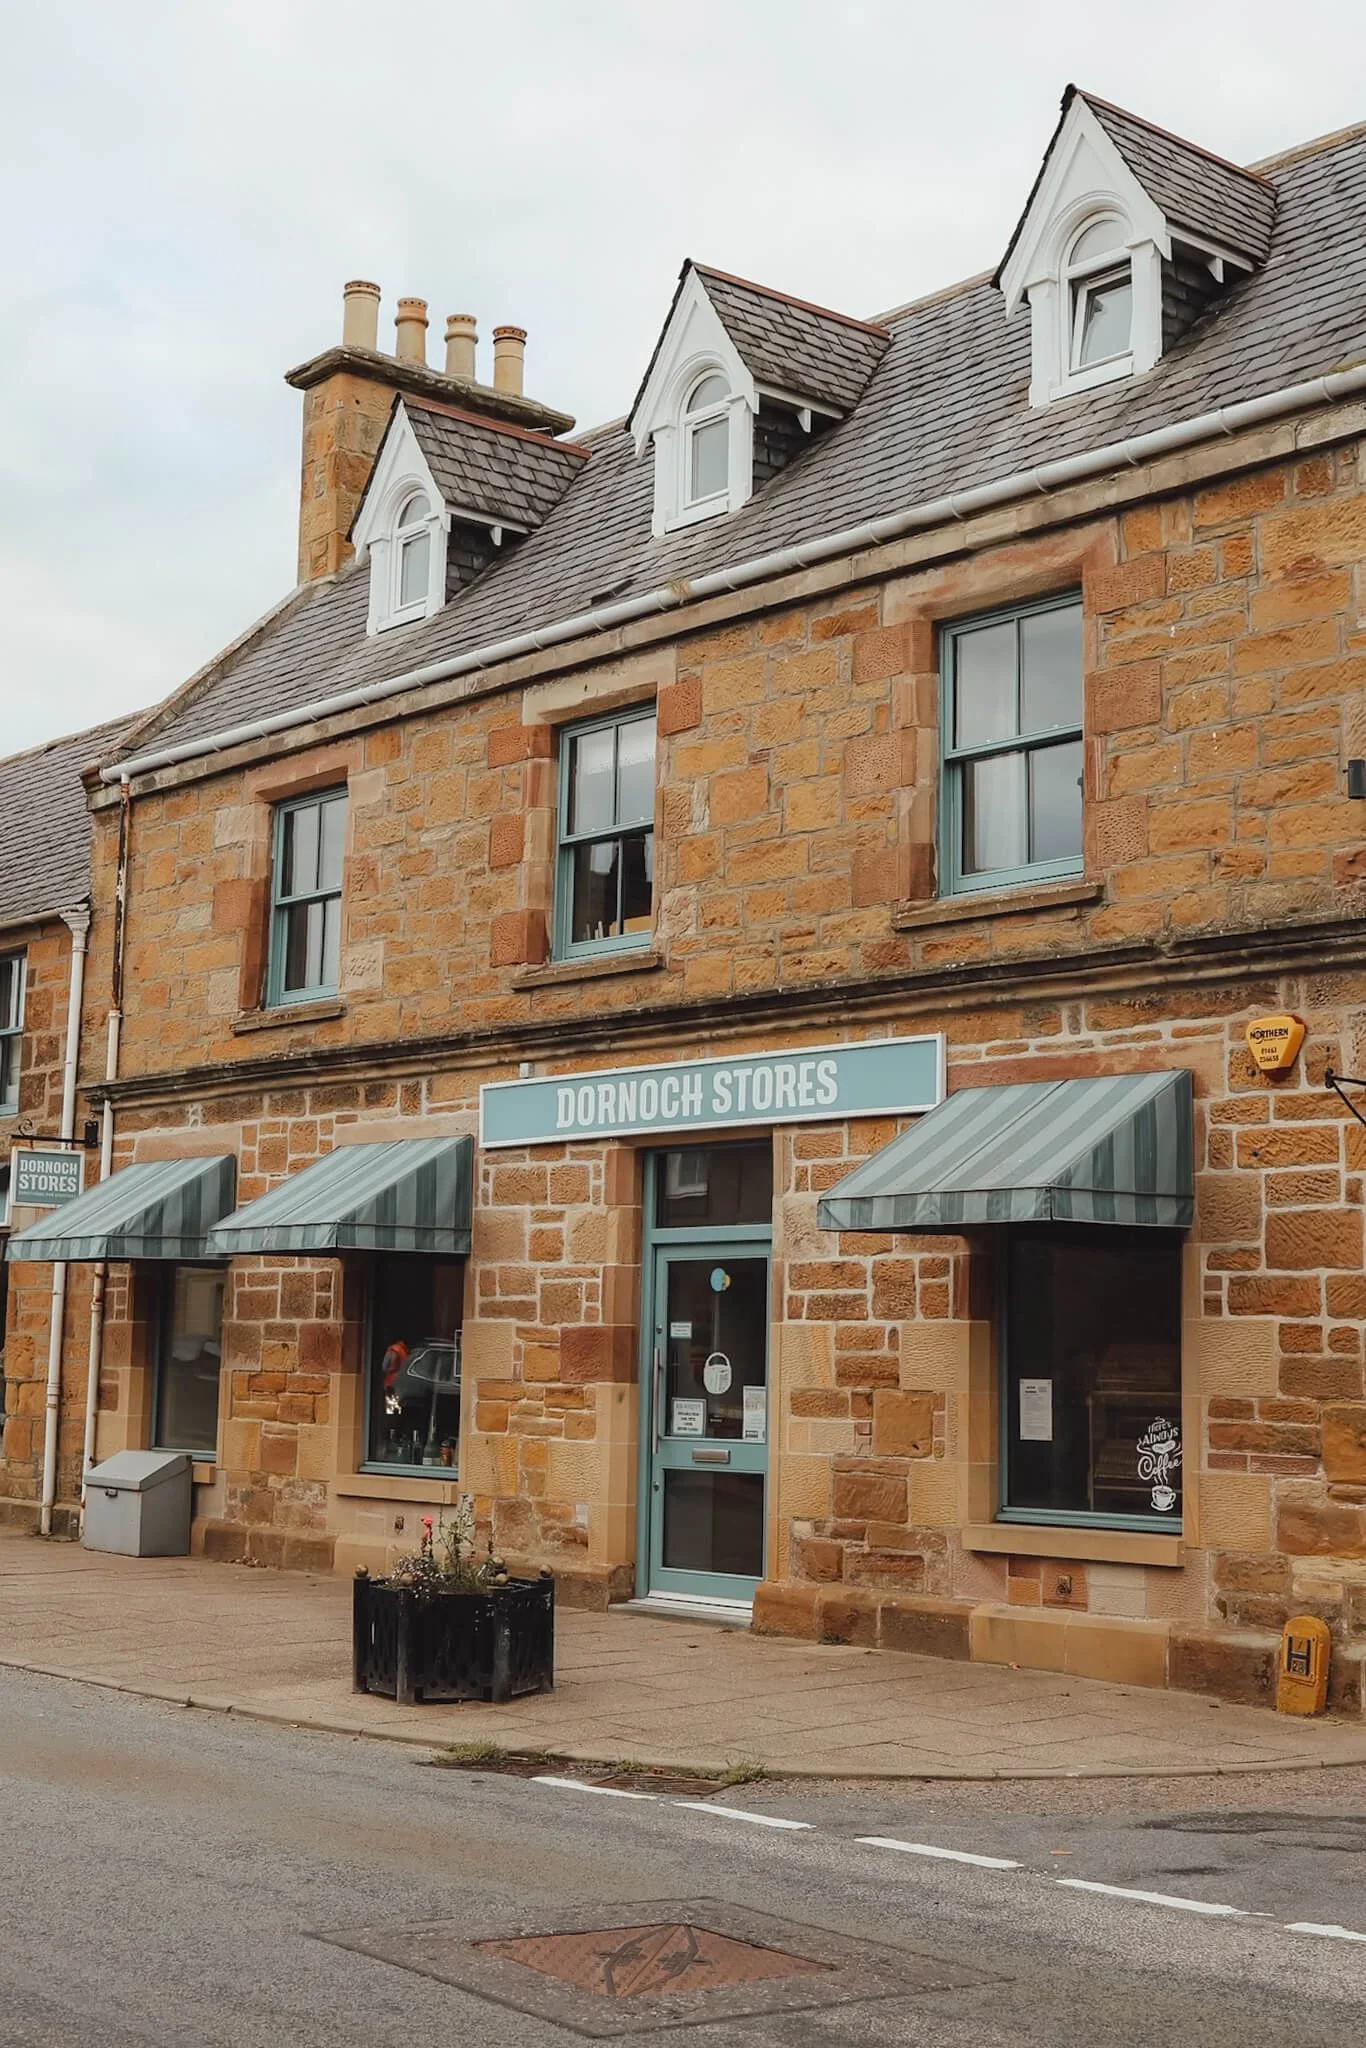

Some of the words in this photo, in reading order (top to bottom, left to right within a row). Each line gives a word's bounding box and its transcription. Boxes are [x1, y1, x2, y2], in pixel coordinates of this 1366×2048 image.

[1250, 1028, 1289, 1040] NORTHERN
[556, 1073, 703, 1129] DORNOCH
[712, 1060, 838, 1115] STORES
[20, 1160, 78, 1175] DORNOCH
[19, 1174, 77, 1192] STORES
[1138, 1453, 1183, 1480] Coffee
